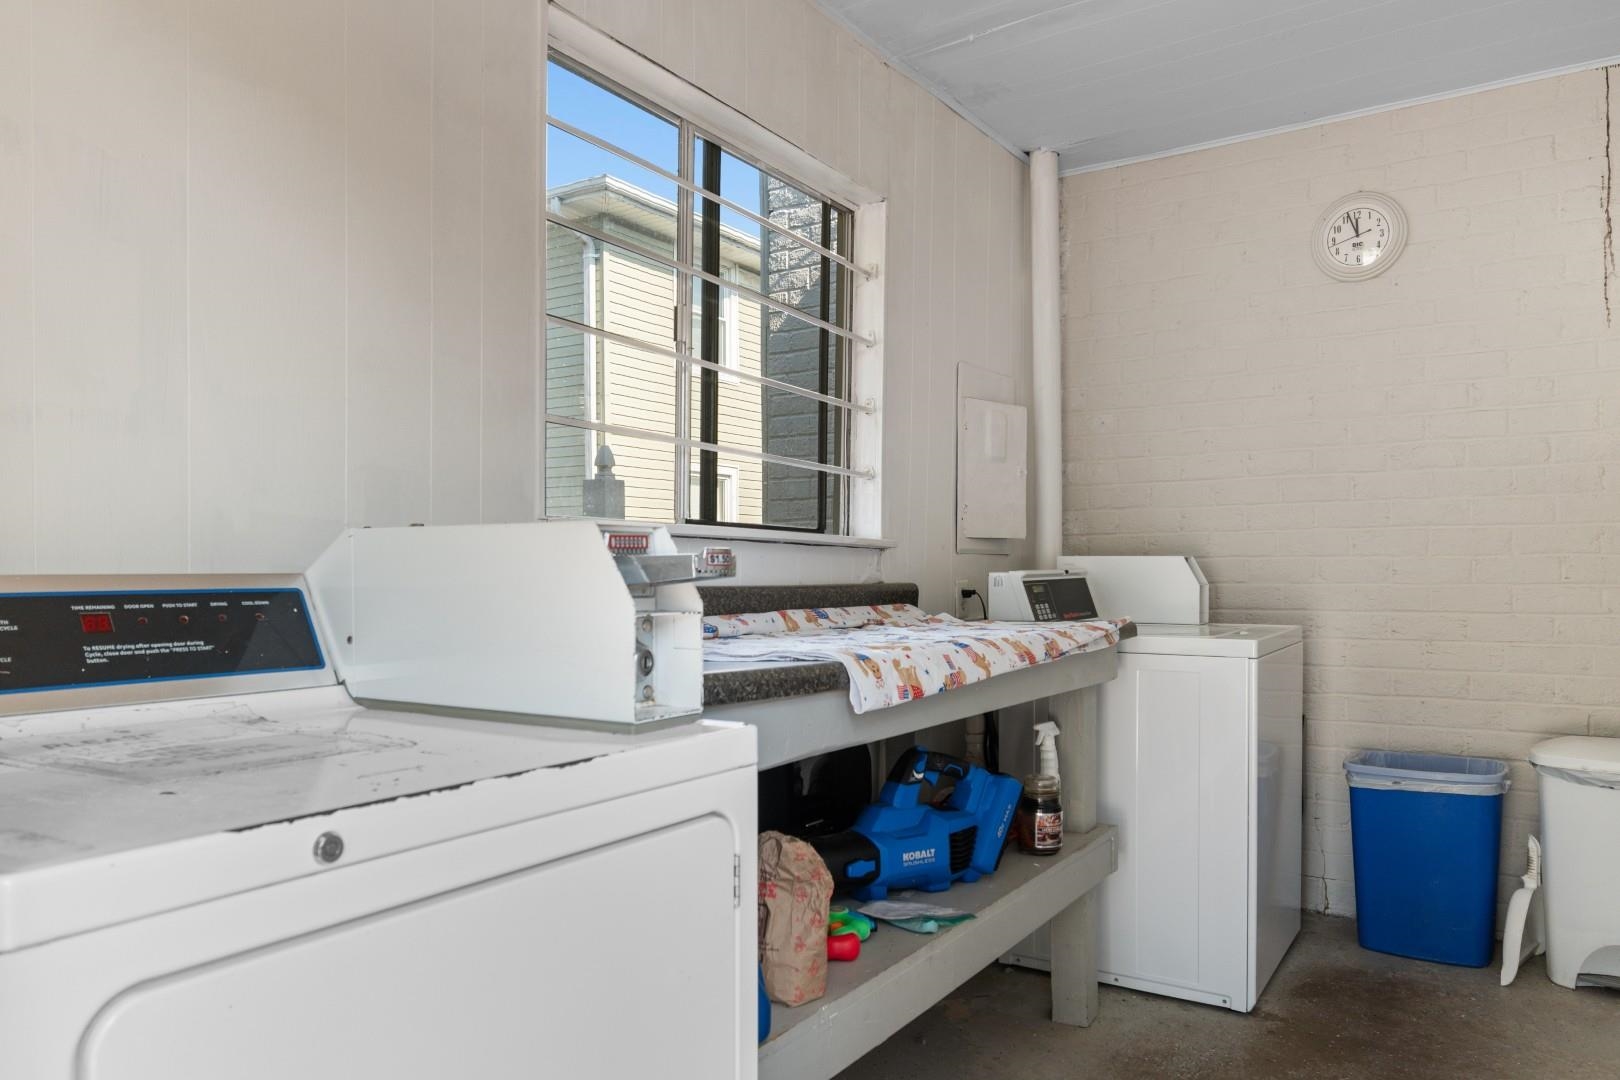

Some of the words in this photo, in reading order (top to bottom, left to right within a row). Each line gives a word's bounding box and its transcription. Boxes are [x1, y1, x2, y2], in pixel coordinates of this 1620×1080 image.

[1353, 210, 1361, 219] 12
[1333, 225, 1342, 234] 10
[1379, 229, 1384, 237] 3
[116, 643, 135, 651] drying
[902, 848, 936, 861] KOBALT
